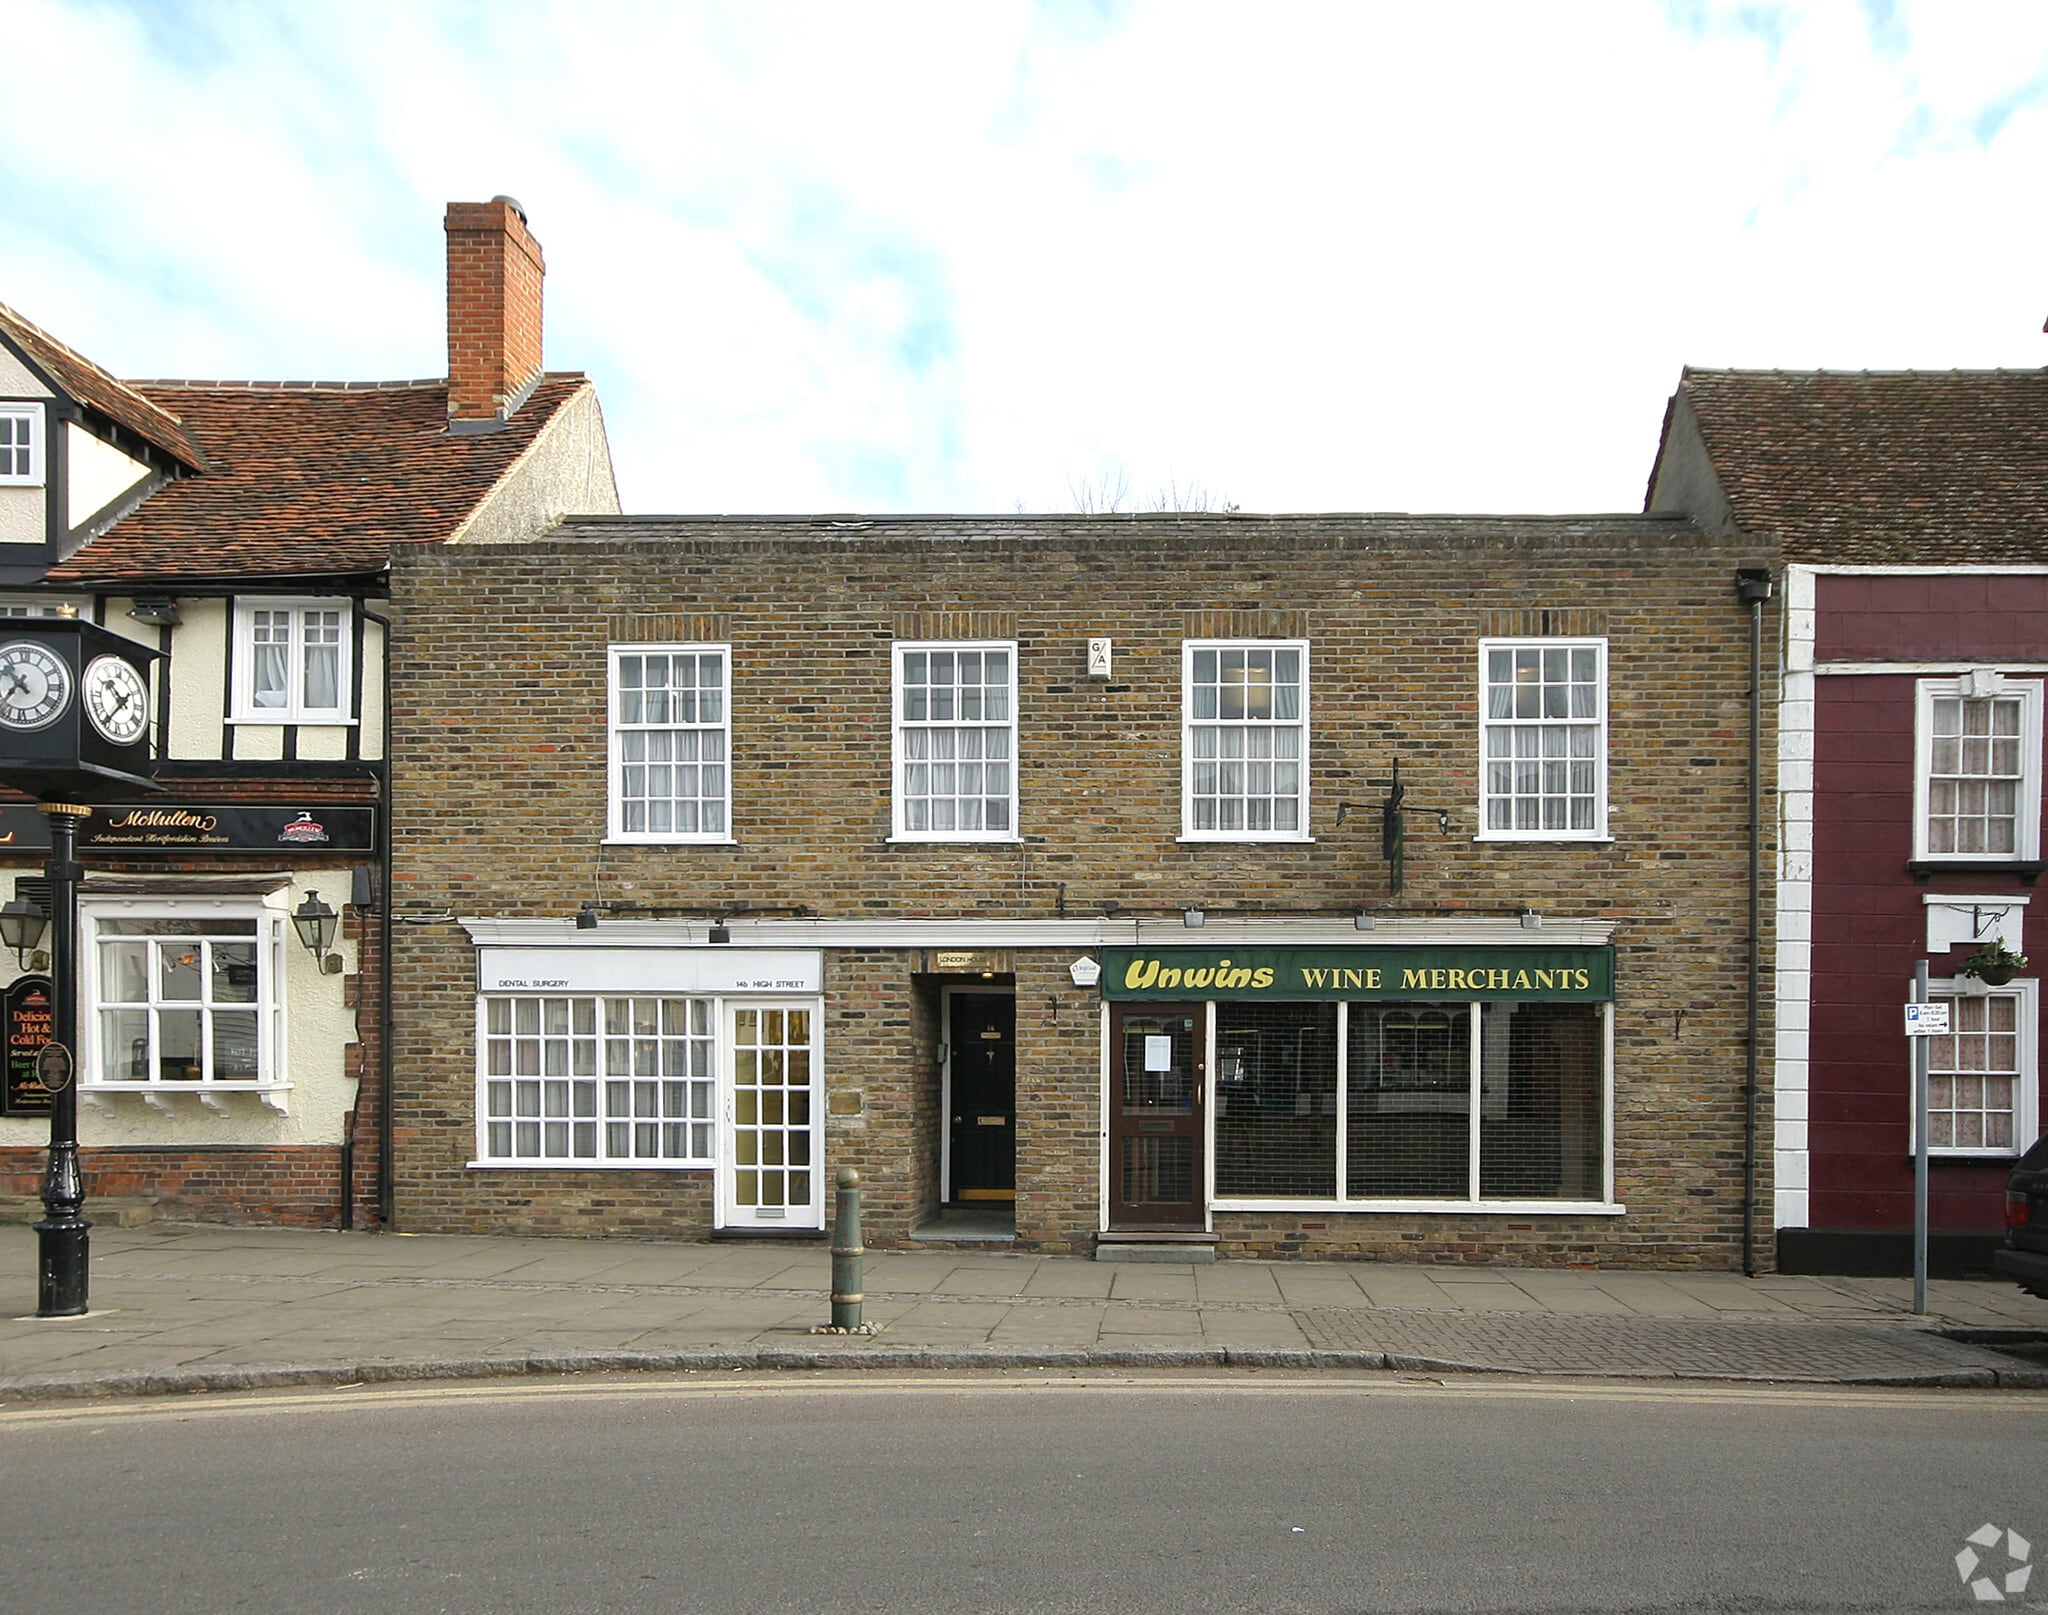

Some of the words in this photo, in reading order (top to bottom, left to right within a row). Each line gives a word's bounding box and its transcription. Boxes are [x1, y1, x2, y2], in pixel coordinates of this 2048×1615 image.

[1092, 643, 1100, 652] G
[1098, 655, 1106, 664] A
[109, 810, 217, 831] McMullen
[90, 834, 143, 844] Independent
[1125, 959, 1274, 989] Unwins
[1301, 968, 1382, 989] WINE
[1400, 968, 1590, 990] MERCHANTS
[498, 979, 528, 987] DENTAL
[532, 979, 569, 987] SURGERY
[753, 980, 772, 988] HIGH
[776, 980, 804, 988] STREET
[13, 1011, 52, 1022] Delicio
[1909, 1007, 1918, 1020] P
[22, 1023, 40, 1033] Hot
[41, 1023, 52, 1033] &
[11, 1034, 35, 1045] Cold
[11, 1060, 31, 1069] Beer
